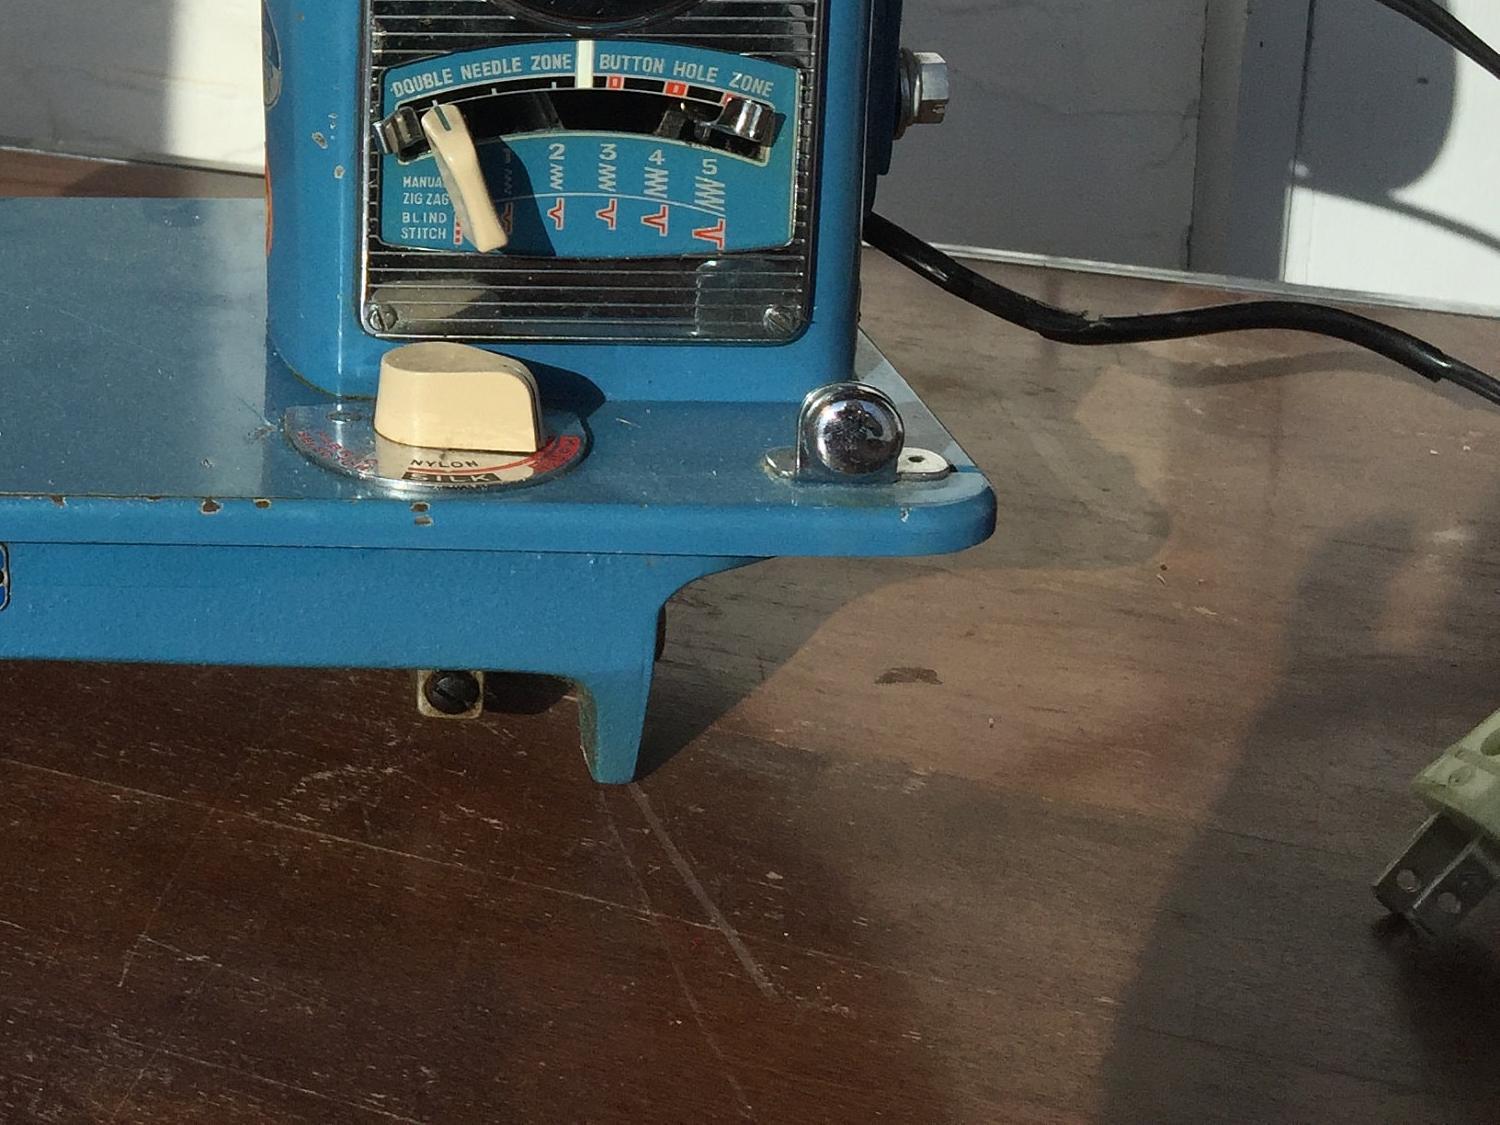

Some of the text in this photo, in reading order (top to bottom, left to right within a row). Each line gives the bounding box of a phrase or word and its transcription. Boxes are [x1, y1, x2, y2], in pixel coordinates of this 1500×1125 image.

[392, 53, 572, 97] DOUBLE NEEDLE ZONE
[599, 53, 775, 97] BUTTON HOLE ZONE
[549, 142, 565, 160] 2
[600, 143, 617, 160] 3
[648, 149, 665, 165] 4
[702, 158, 718, 175] 5
[403, 176, 445, 188] MANUA
[403, 193, 449, 206] ZIG ZAG
[402, 212, 447, 224] BLIND
[400, 228, 447, 240] STITCH
[410, 459, 480, 469] NYLON
[410, 473, 490, 483] SILK
